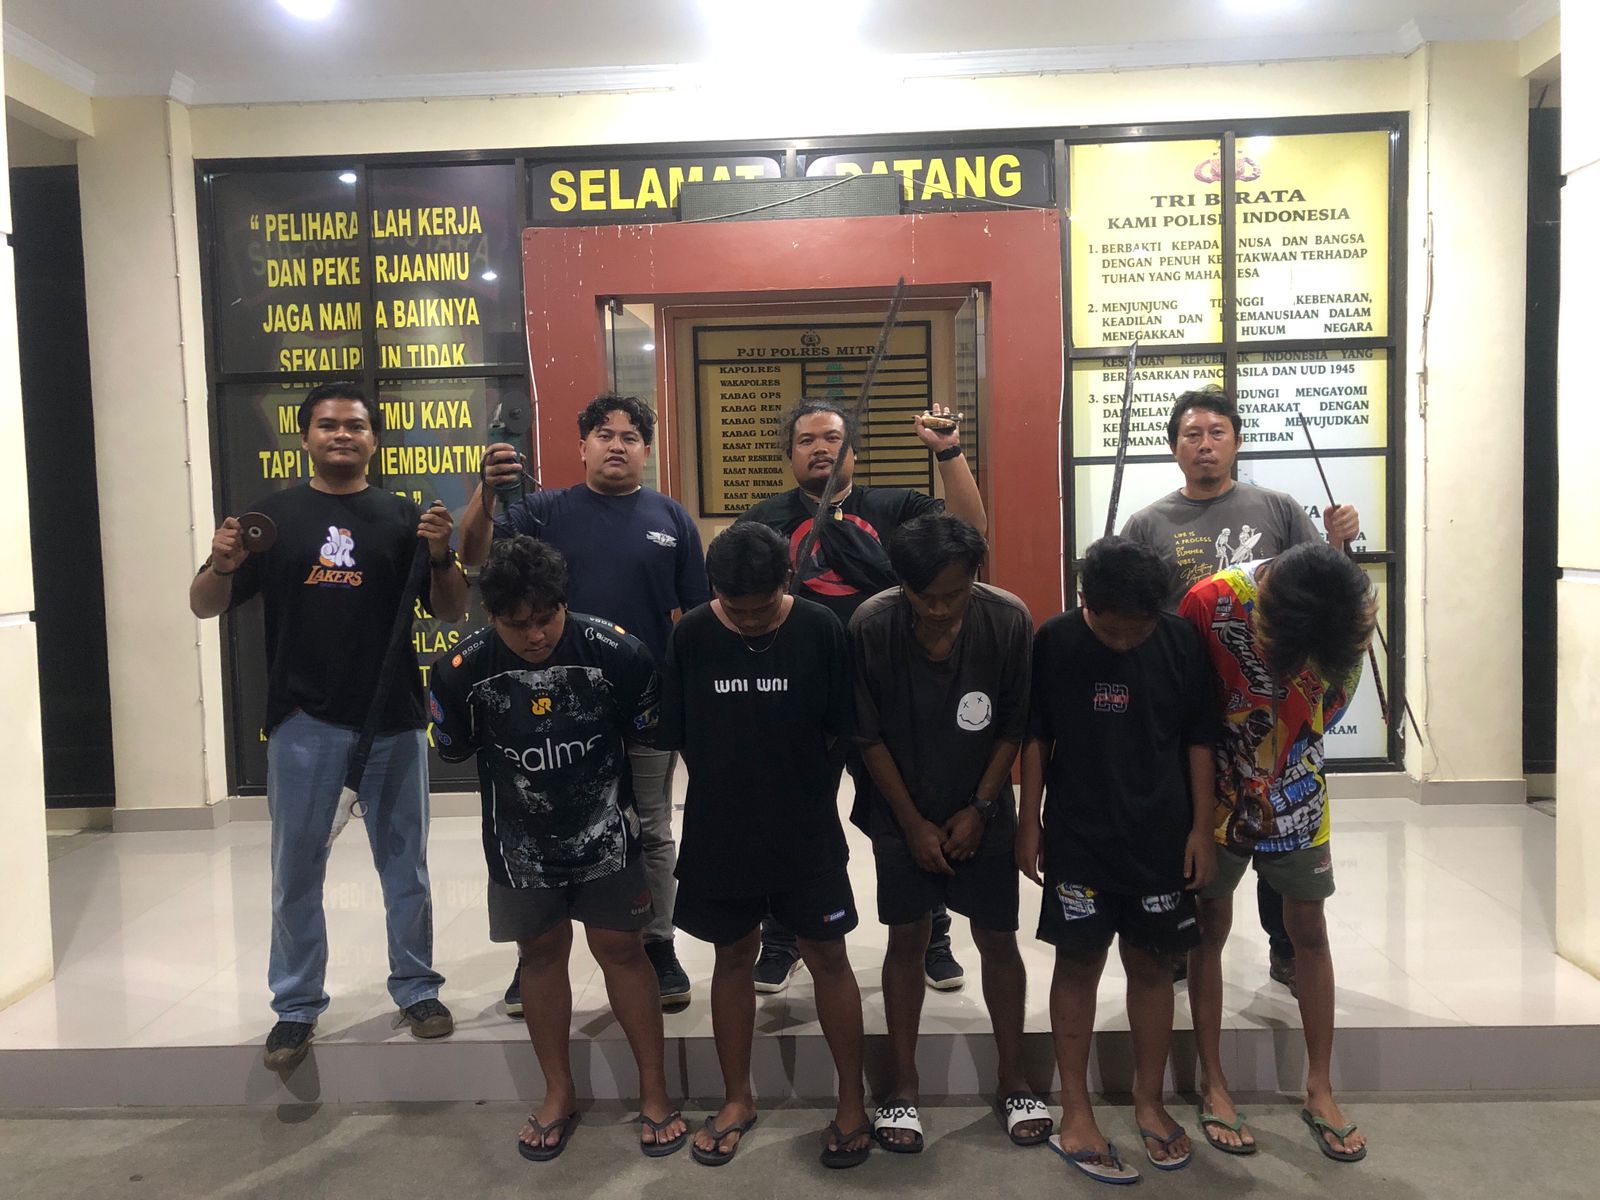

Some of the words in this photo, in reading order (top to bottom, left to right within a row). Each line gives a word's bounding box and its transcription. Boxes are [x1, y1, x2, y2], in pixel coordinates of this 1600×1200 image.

[550, 165, 764, 212] SELAM
[835, 154, 1022, 201] TANG
[1150, 194, 1195, 207] TRI
[418, 206, 482, 236] KERJA
[1107, 216, 1157, 229] KAMI
[1243, 208, 1350, 223] INDONESIA
[1088, 244, 1098, 254] 1.
[1102, 242, 1161, 254] BERBAKTI
[1172, 240, 1220, 251] KEPADA
[1239, 237, 1272, 248] NUSA
[1282, 235, 1308, 246] DAN
[1315, 233, 1365, 245] BANGSA
[1102, 257, 1153, 269] DENGAN
[1160, 255, 1201, 266] PENUH
[1301, 248, 1368, 261] TERHADAP
[267, 258, 306, 288] DAN
[1102, 273, 1145, 284] TUHAN
[1149, 271, 1181, 282] YANG
[1185, 270, 1222, 281] MAHA
[1237, 268, 1260, 279] ESA
[1087, 304, 1098, 313] 2.
[1102, 300, 1178, 314] MENJUNJUNG
[1296, 293, 1373, 305] KEBENARAN,
[263, 303, 314, 333] JAGA
[394, 298, 480, 328] BAIKNYA
[1102, 316, 1162, 328] KEADILAN
[1179, 314, 1203, 324] DAN
[1329, 307, 1371, 318] DALAM
[1102, 329, 1184, 341] MENEGAKKAN
[1241, 325, 1286, 336] HUKUM
[1324, 322, 1373, 333] NEGARA
[407, 343, 465, 369] TIDAK
[737, 348, 766, 357] PJU
[770, 347, 830, 357] POLRES
[1102, 356, 1165, 368] KESUAN
[1262, 351, 1328, 362] INDONESIA
[1341, 349, 1373, 359] YANG
[720, 366, 781, 374] KAPOLRES
[1103, 369, 1190, 382] BERASARKAN
[1272, 366, 1297, 376] DAN
[1301, 365, 1326, 375] UUD
[1330, 364, 1355, 374] 1945
[720, 379, 781, 387] WAKAPOLRES
[720, 392, 756, 400] KABAG
[760, 391, 781, 399] OPS
[1088, 394, 1099, 404] 3.
[1103, 392, 1176, 404] SENNTIASA
[1296, 386, 1367, 397] MENGAYOMI
[421, 401, 472, 429] KAYA
[721, 405, 756, 413] KABAG
[760, 404, 782, 412] REN
[1238, 403, 1301, 414] SYARAKAT
[1320, 400, 1369, 411] DENGAN
[721, 418, 756, 426] KABAG
[722, 430, 756, 438] KABAG
[1103, 436, 1169, 447] KEMANAN
[259, 450, 301, 478] TAPI
[381, 446, 486, 475] EMBUATM
[876, 1106, 921, 1123] Supe
[1006, 1097, 1047, 1114] Supe
